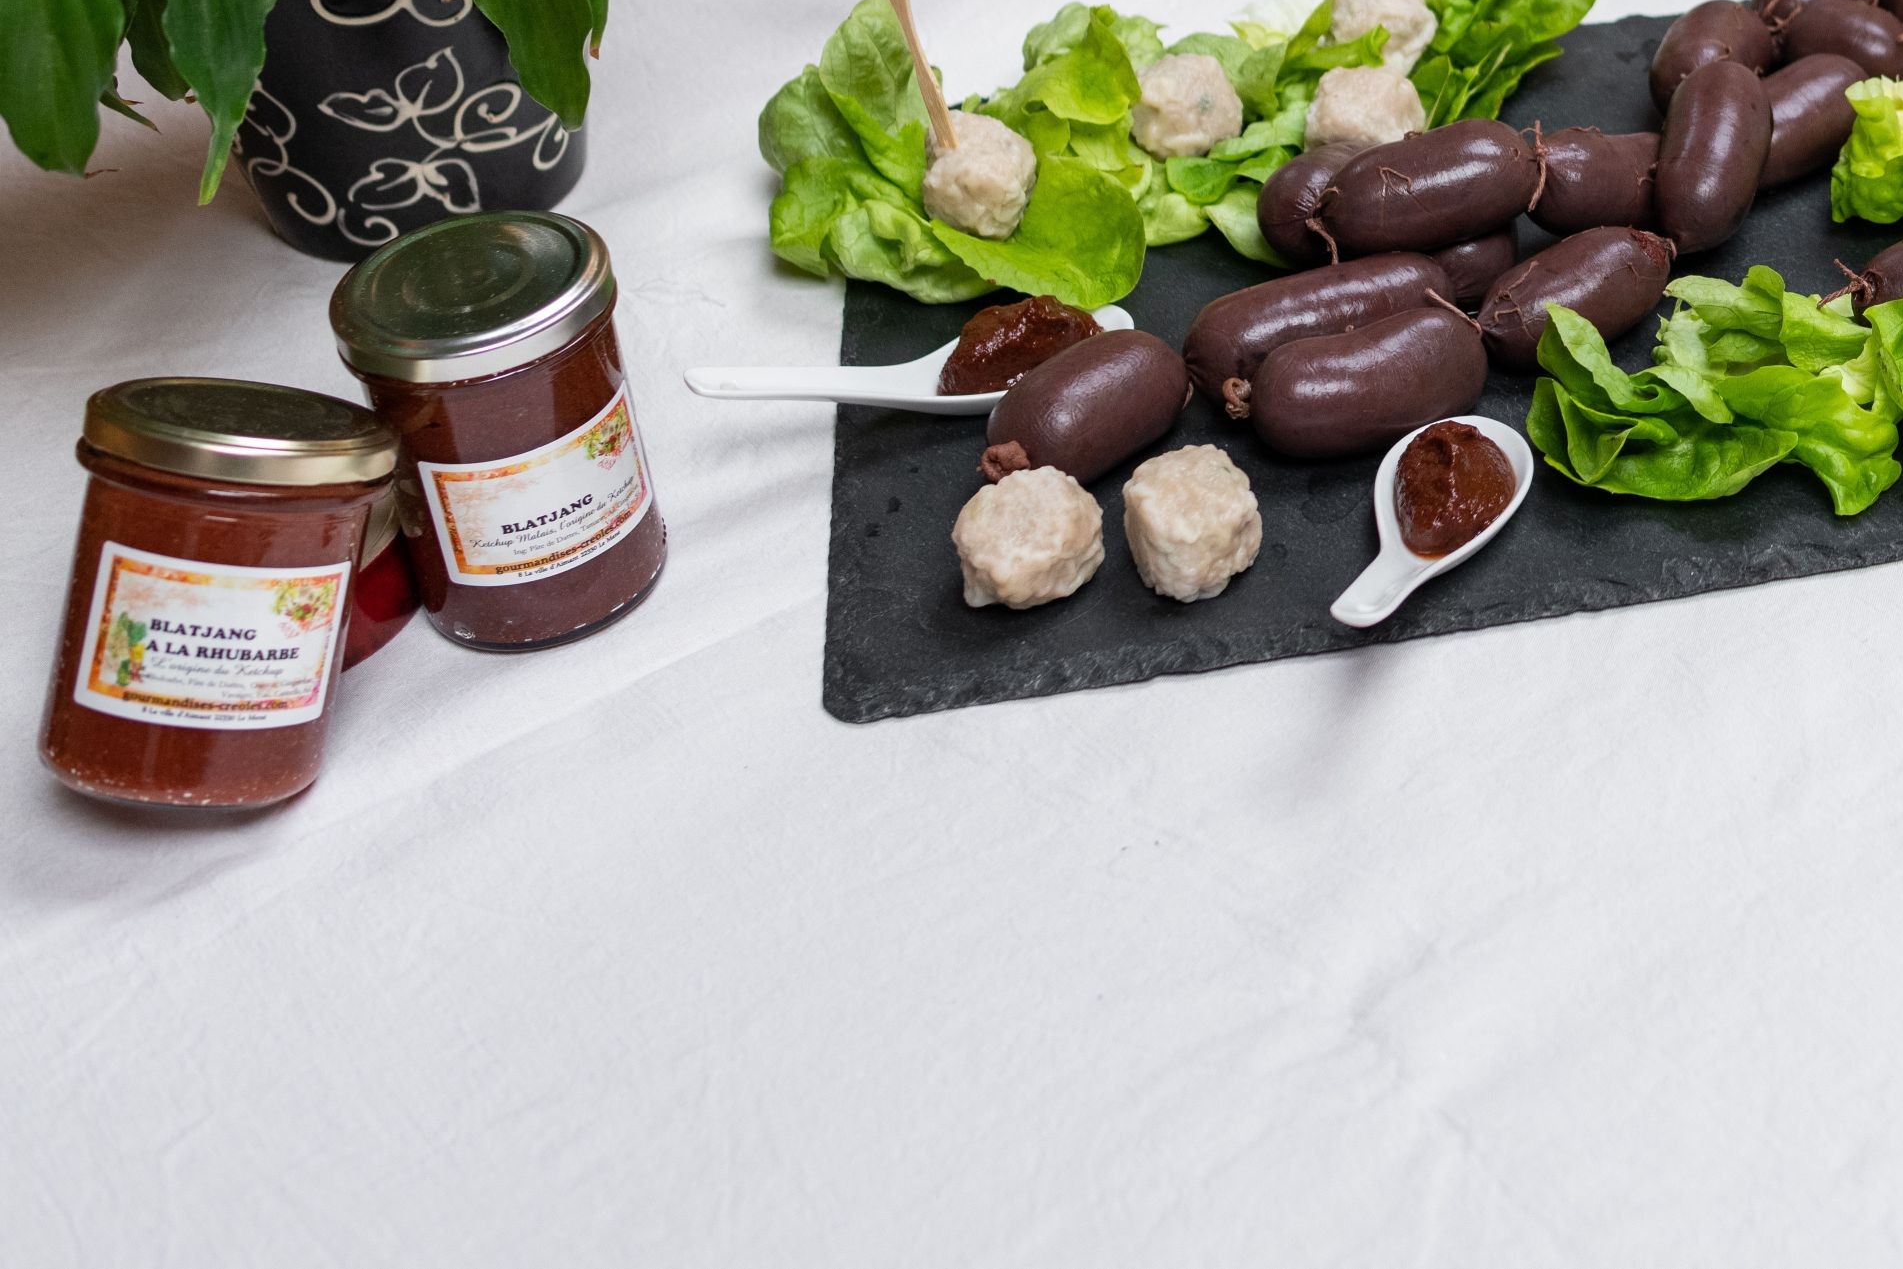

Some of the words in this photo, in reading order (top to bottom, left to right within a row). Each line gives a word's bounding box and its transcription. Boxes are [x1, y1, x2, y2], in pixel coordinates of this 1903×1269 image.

[501, 493, 594, 535] BLATJANG
[470, 537, 514, 549] Ketchup
[495, 509, 633, 575] gourmandises-creoles.com
[150, 618, 257, 641] BLATJANG
[146, 640, 159, 652] A
[165, 642, 190, 657] LA
[196, 644, 300, 662] RHUBARBE
[122, 690, 289, 713] gourmandises-creoles.com
